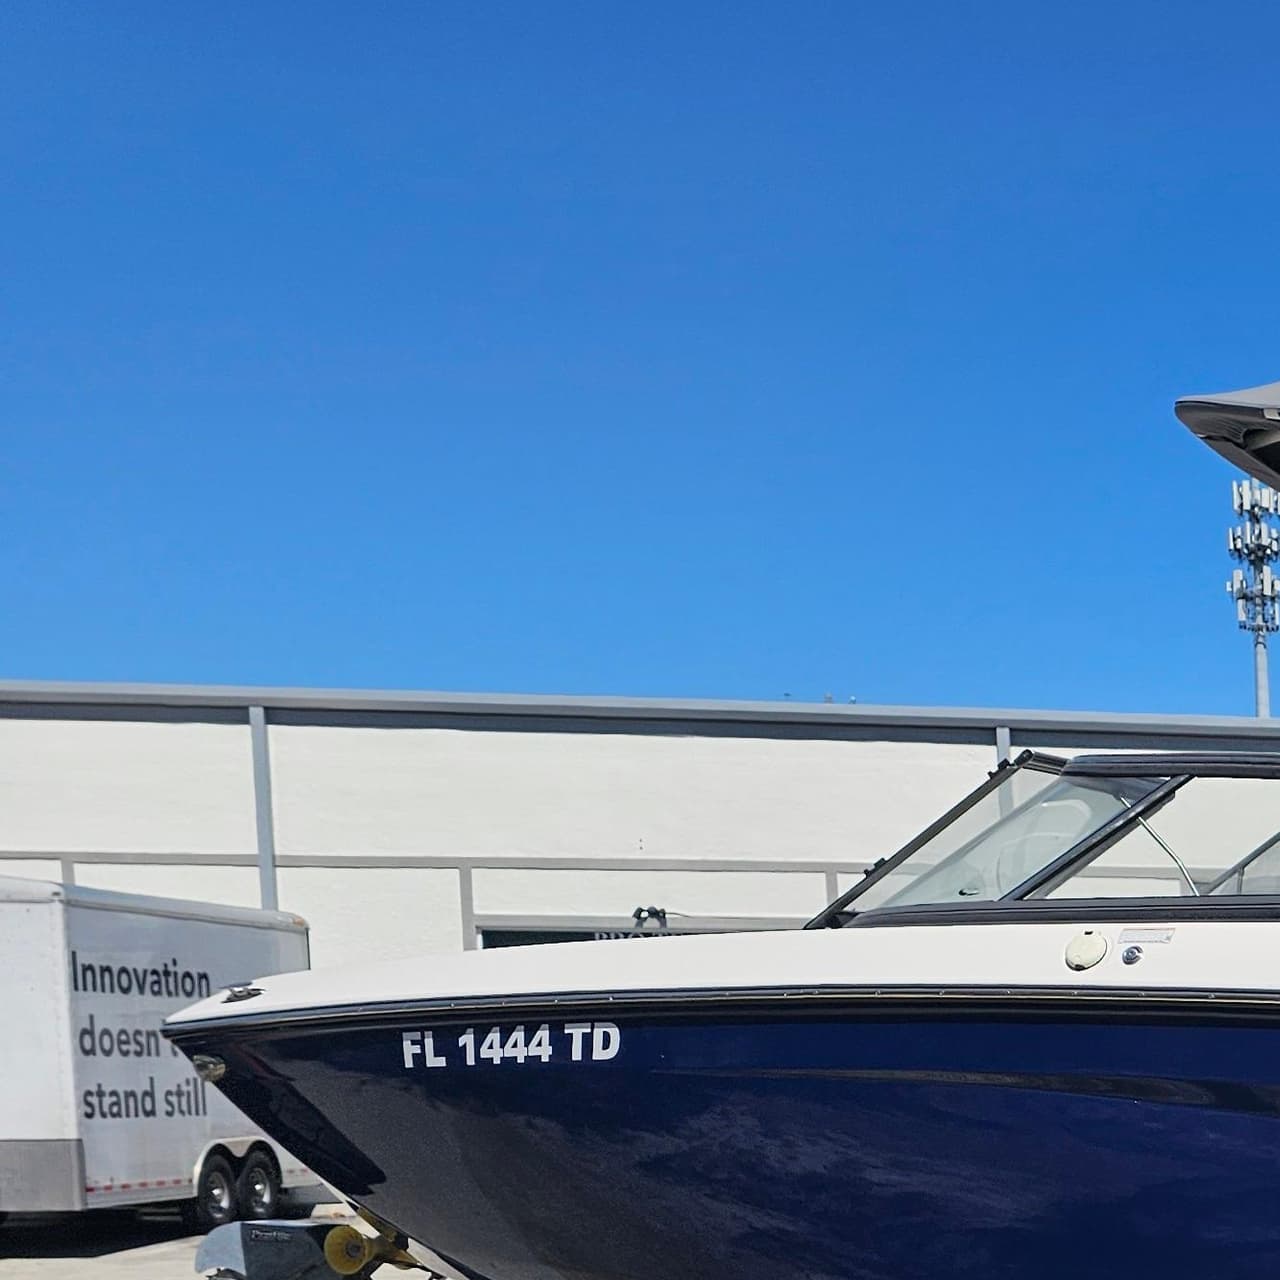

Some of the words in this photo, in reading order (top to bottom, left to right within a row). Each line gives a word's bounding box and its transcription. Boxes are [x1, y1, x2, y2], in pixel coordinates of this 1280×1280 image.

[71, 950, 210, 998] Innovation
[79, 1014, 178, 1057] doesn
[402, 1031, 447, 1068] FL
[458, 1024, 552, 1065] 1444
[564, 1022, 620, 1061] TD
[82, 1076, 157, 1119] stand
[164, 1077, 207, 1117] still
